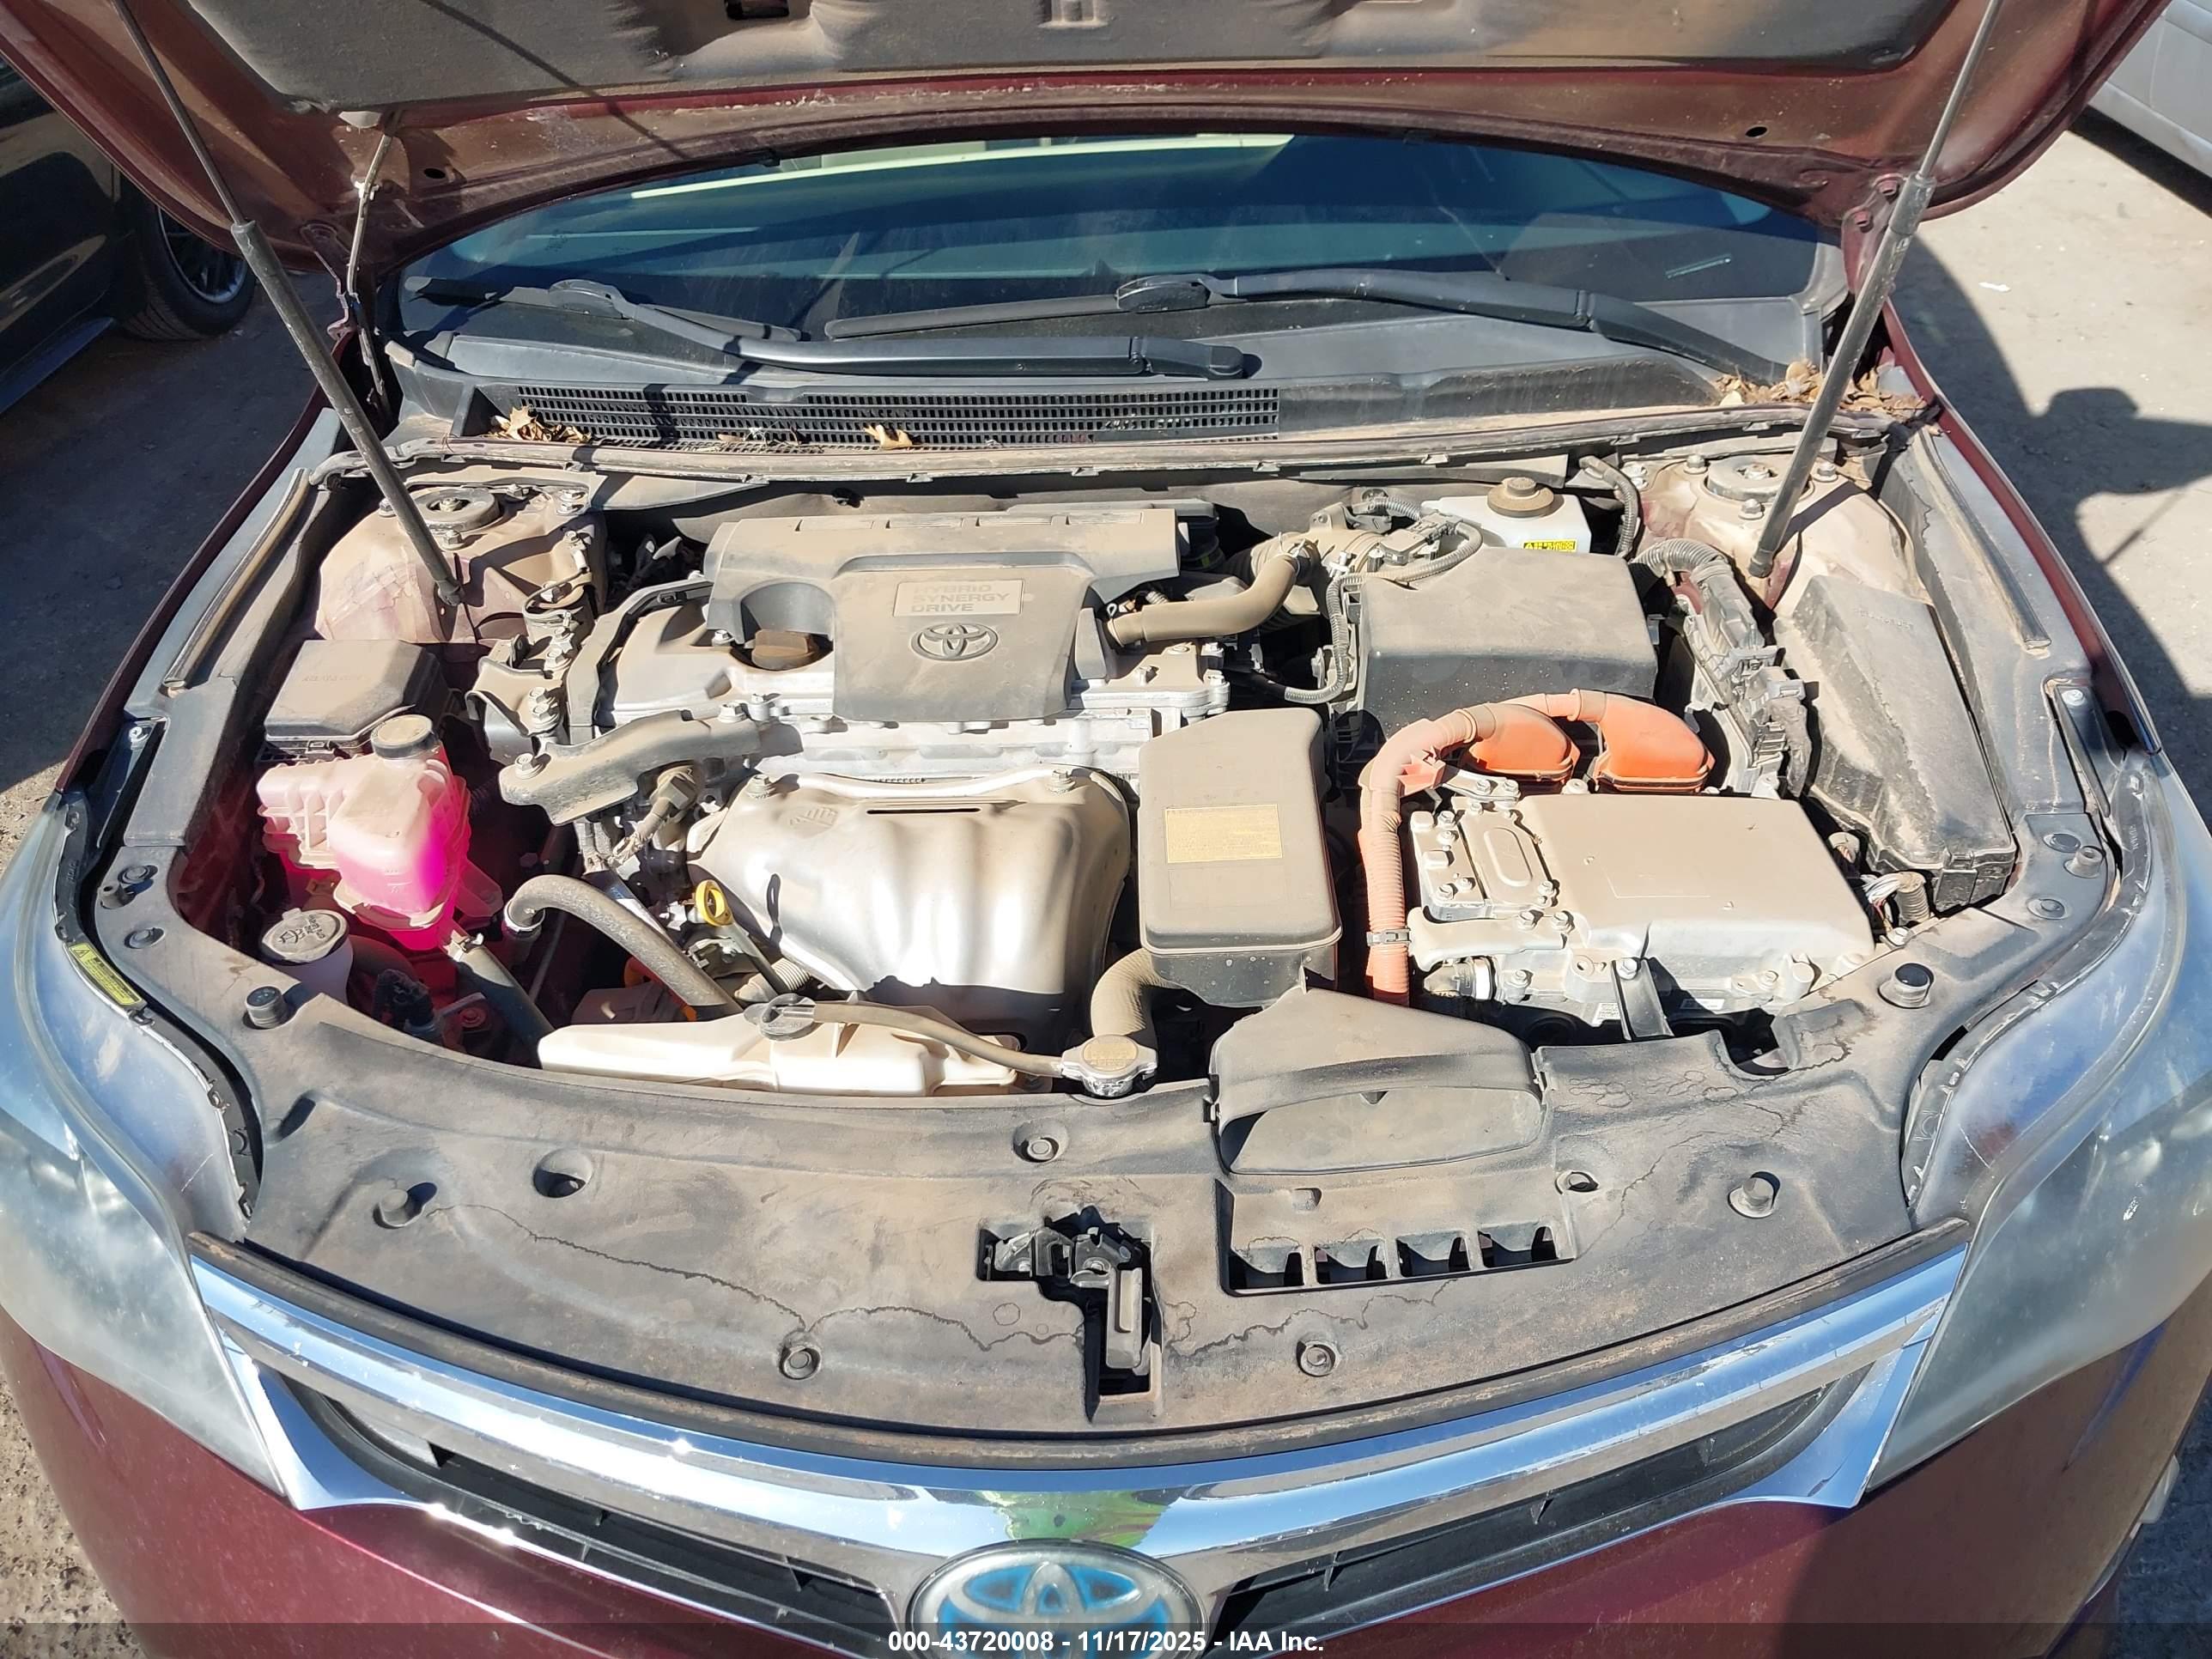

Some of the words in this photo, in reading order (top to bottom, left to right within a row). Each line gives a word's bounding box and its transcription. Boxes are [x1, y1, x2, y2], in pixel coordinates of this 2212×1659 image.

[914, 585, 991, 594] HYBRID
[913, 592, 1011, 603] SYNERGY
[911, 603, 975, 612] DRIVE
